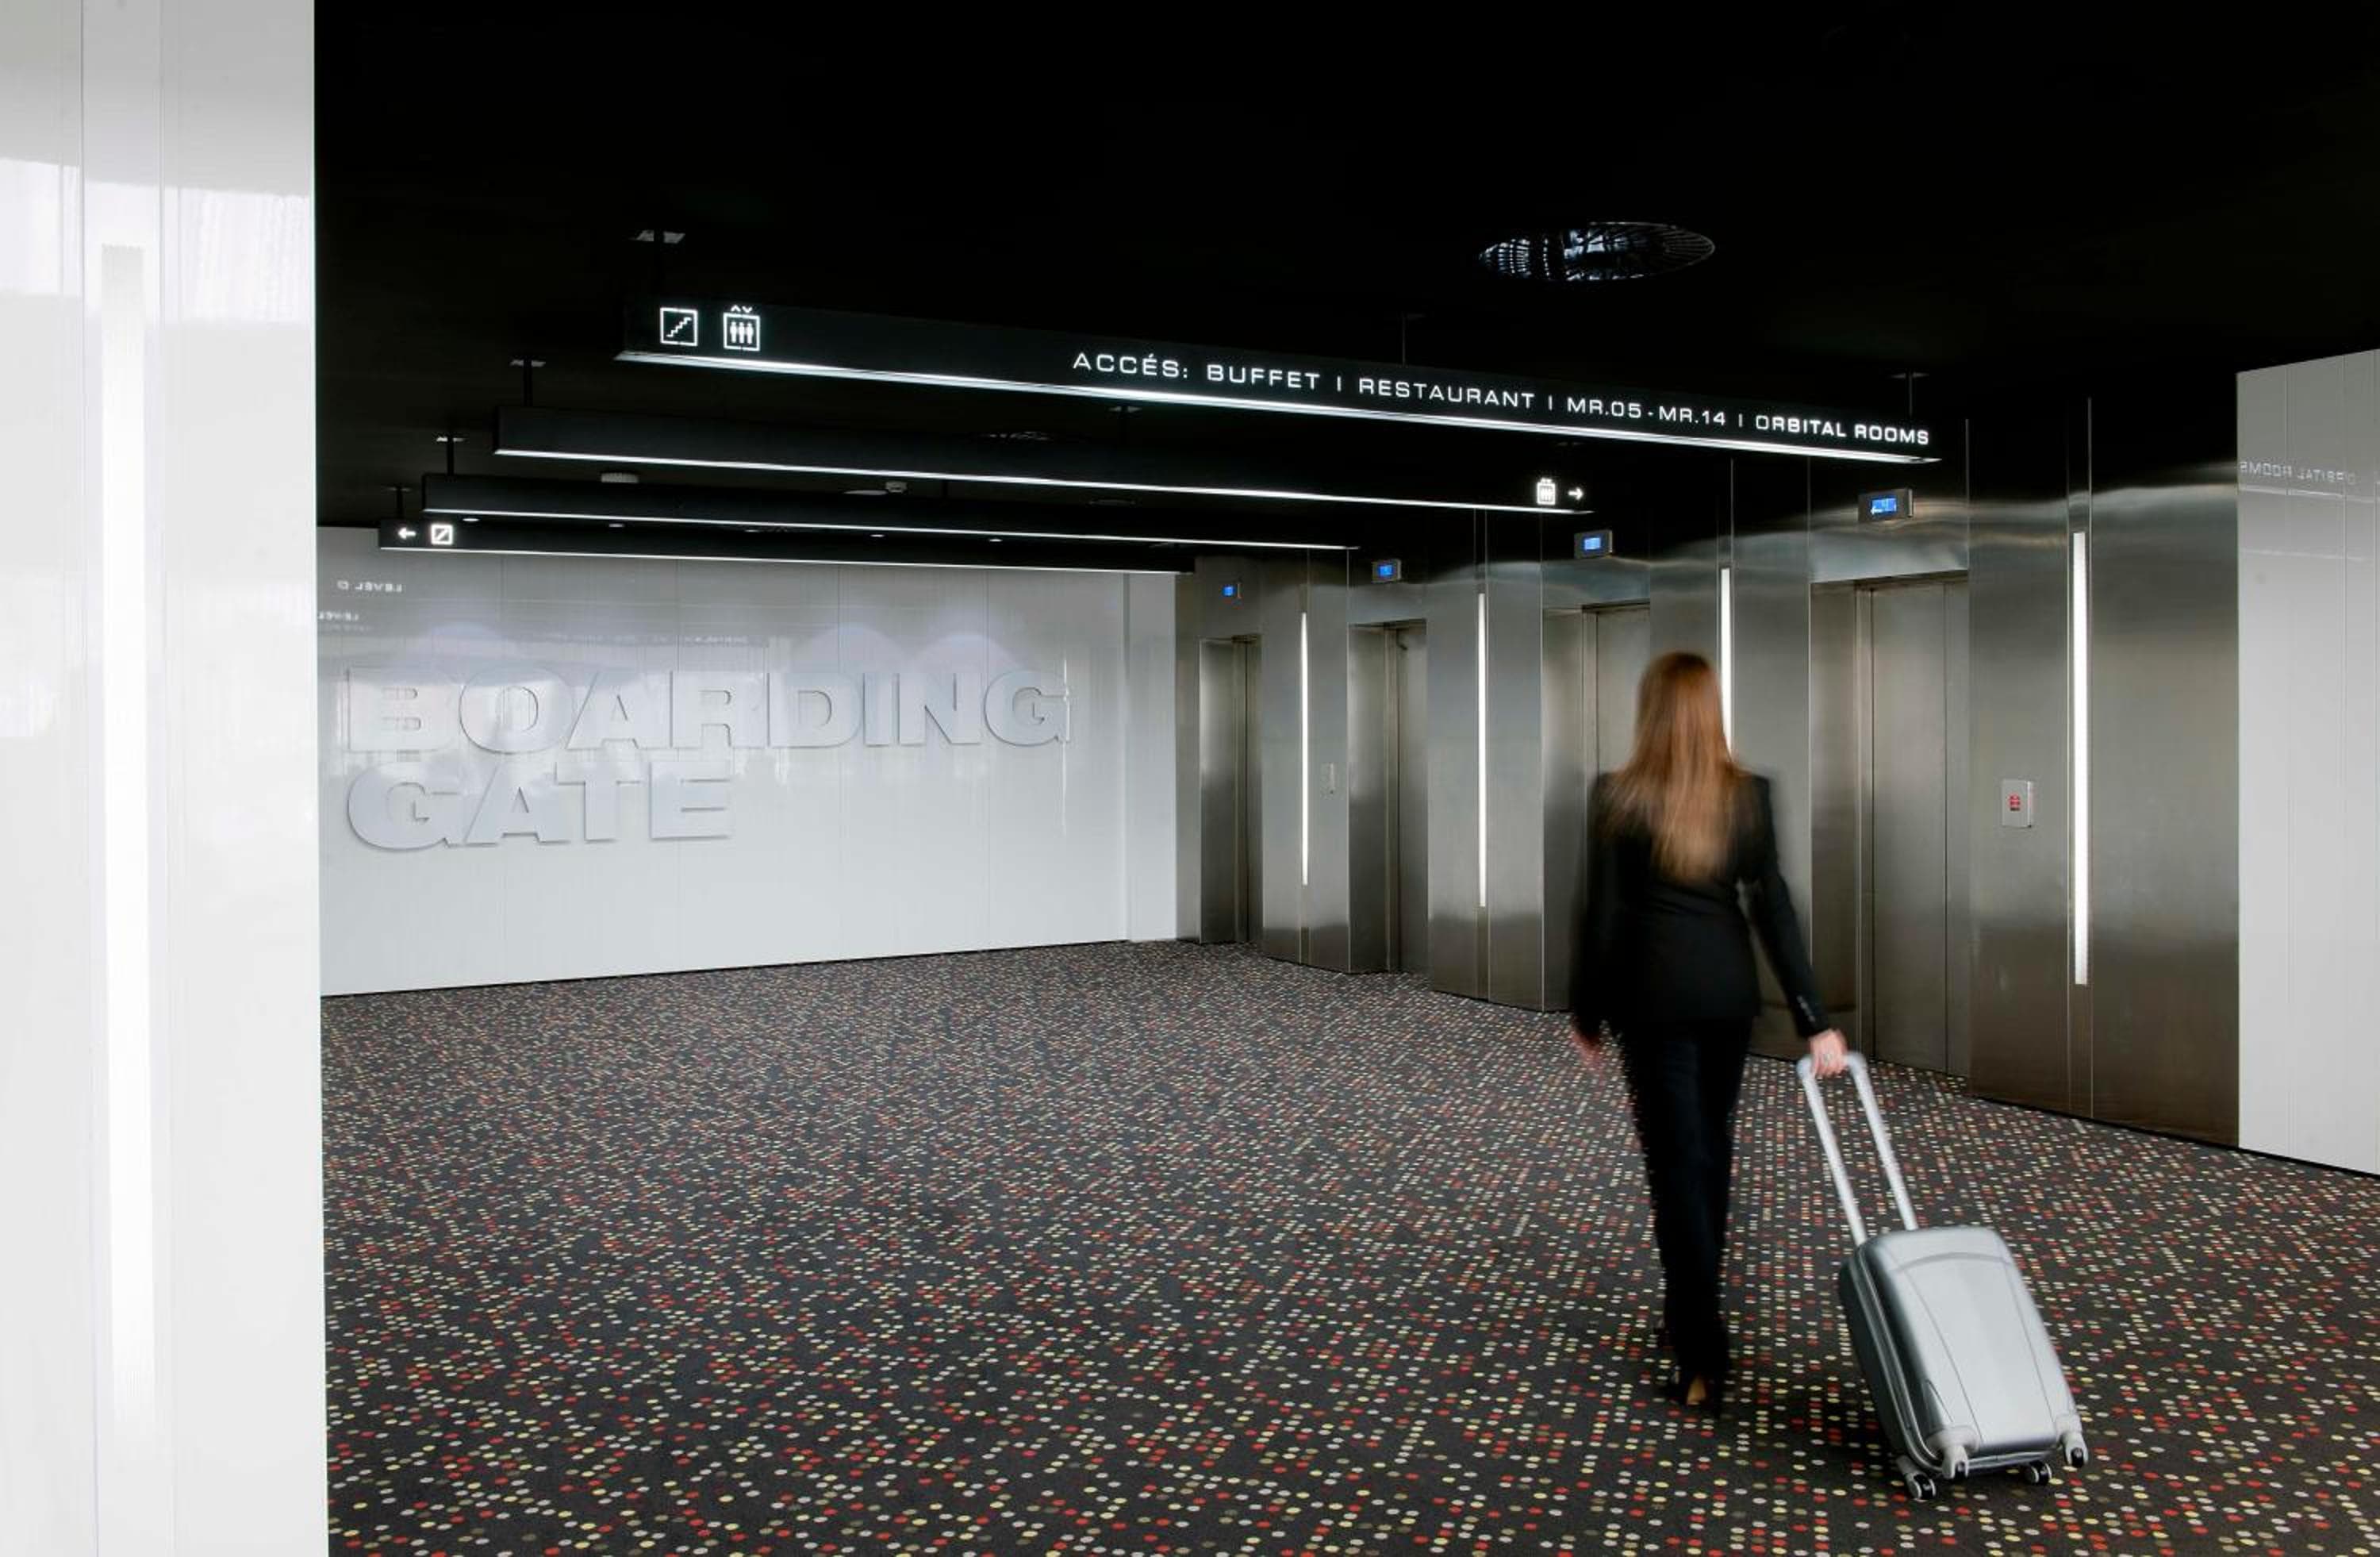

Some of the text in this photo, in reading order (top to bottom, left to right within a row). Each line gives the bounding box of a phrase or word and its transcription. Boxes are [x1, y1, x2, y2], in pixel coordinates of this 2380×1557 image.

[1073, 353, 1188, 379] ACCÉS:
[1207, 364, 1320, 390] BUFFET
[1359, 378, 1535, 409] RESTAURANT
[1756, 415, 1846, 437] ORBITAL
[1854, 424, 1929, 445] ROOMS
[347, 665, 1070, 754] BOARDING
[347, 762, 731, 851] GATE
